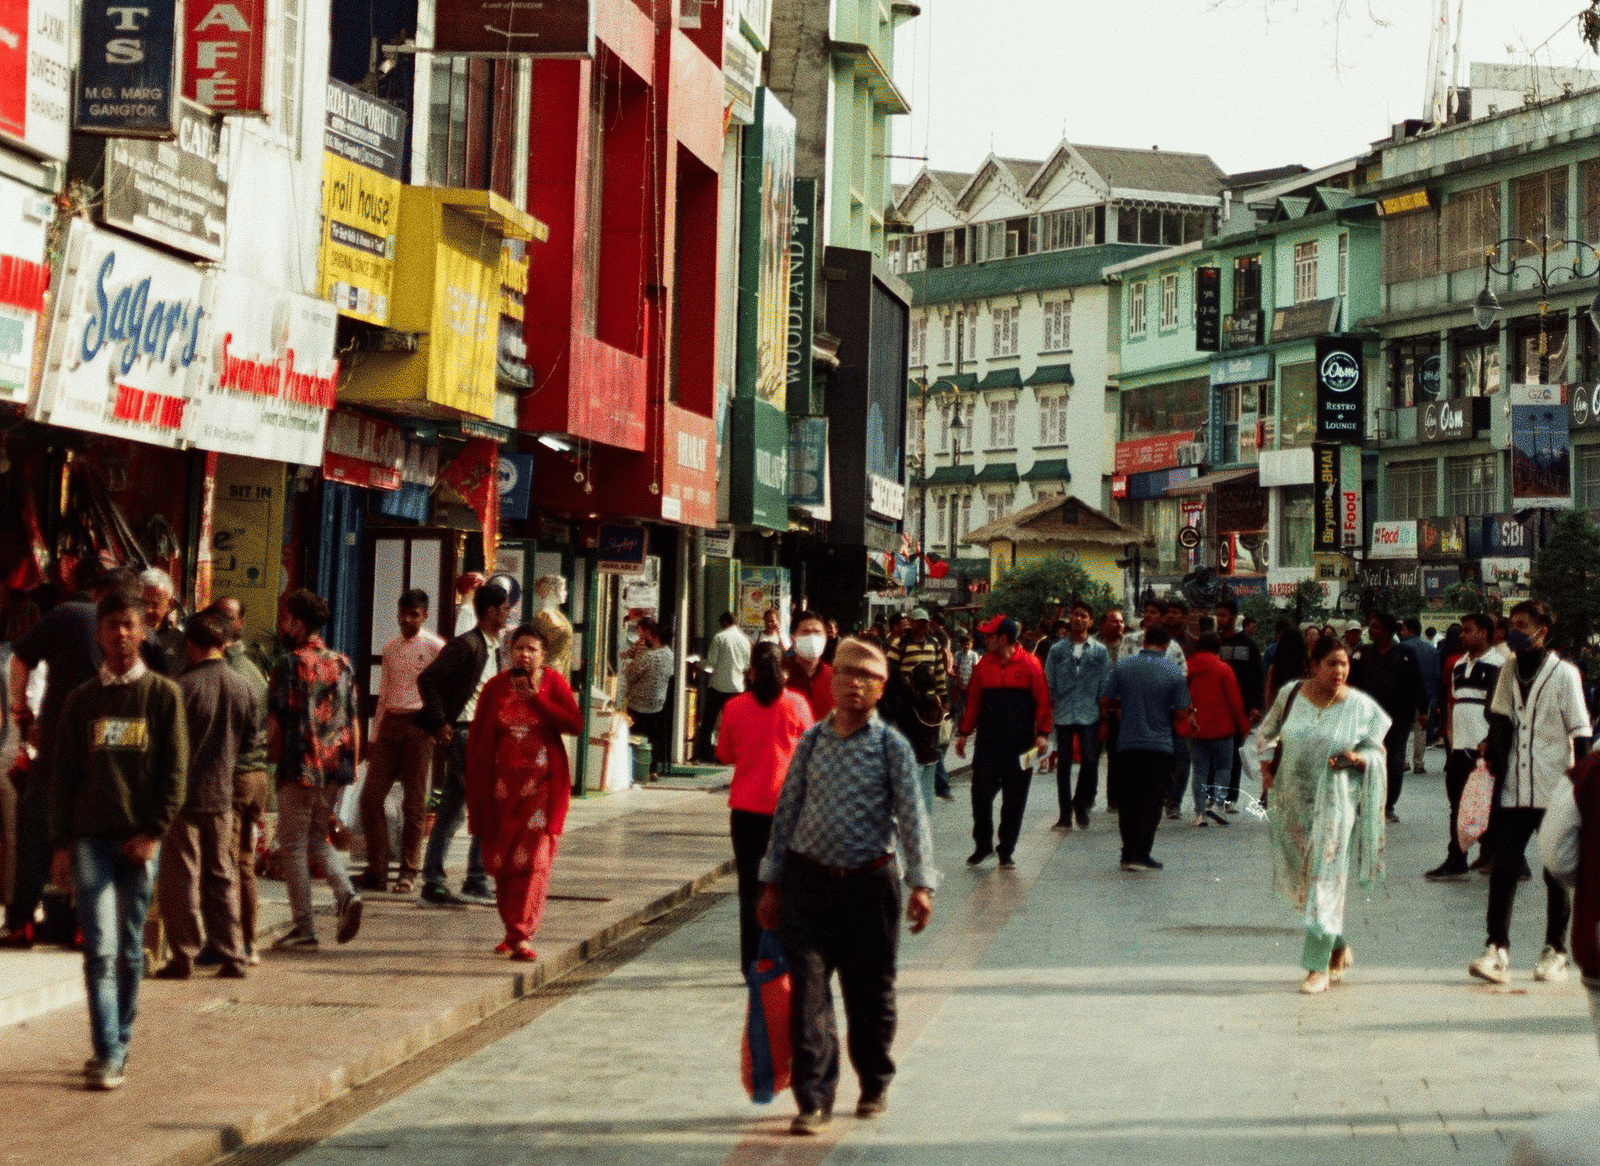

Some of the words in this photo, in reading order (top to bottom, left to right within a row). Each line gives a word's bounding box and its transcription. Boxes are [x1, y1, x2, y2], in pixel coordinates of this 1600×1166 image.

[31, 49, 69, 92] SWEETS
[85, 86, 117, 99] M.G.
[121, 87, 163, 99] MARG
[89, 103, 157, 117] GANGTOK
[332, 171, 354, 213] roll
[357, 175, 390, 226] house
[81, 250, 204, 376] Sagar's
[787, 240, 806, 385] WOODLAND
[1326, 401, 1357, 411] RESTRO
[1325, 421, 1358, 430] LOUNGE
[1321, 450, 1333, 483] BHAI
[228, 484, 252, 498] SIT
[256, 486, 272, 499] IN
[1343, 492, 1356, 530] Food
[1380, 526, 1399, 545] Food
[1501, 521, 1524, 547] SBI
